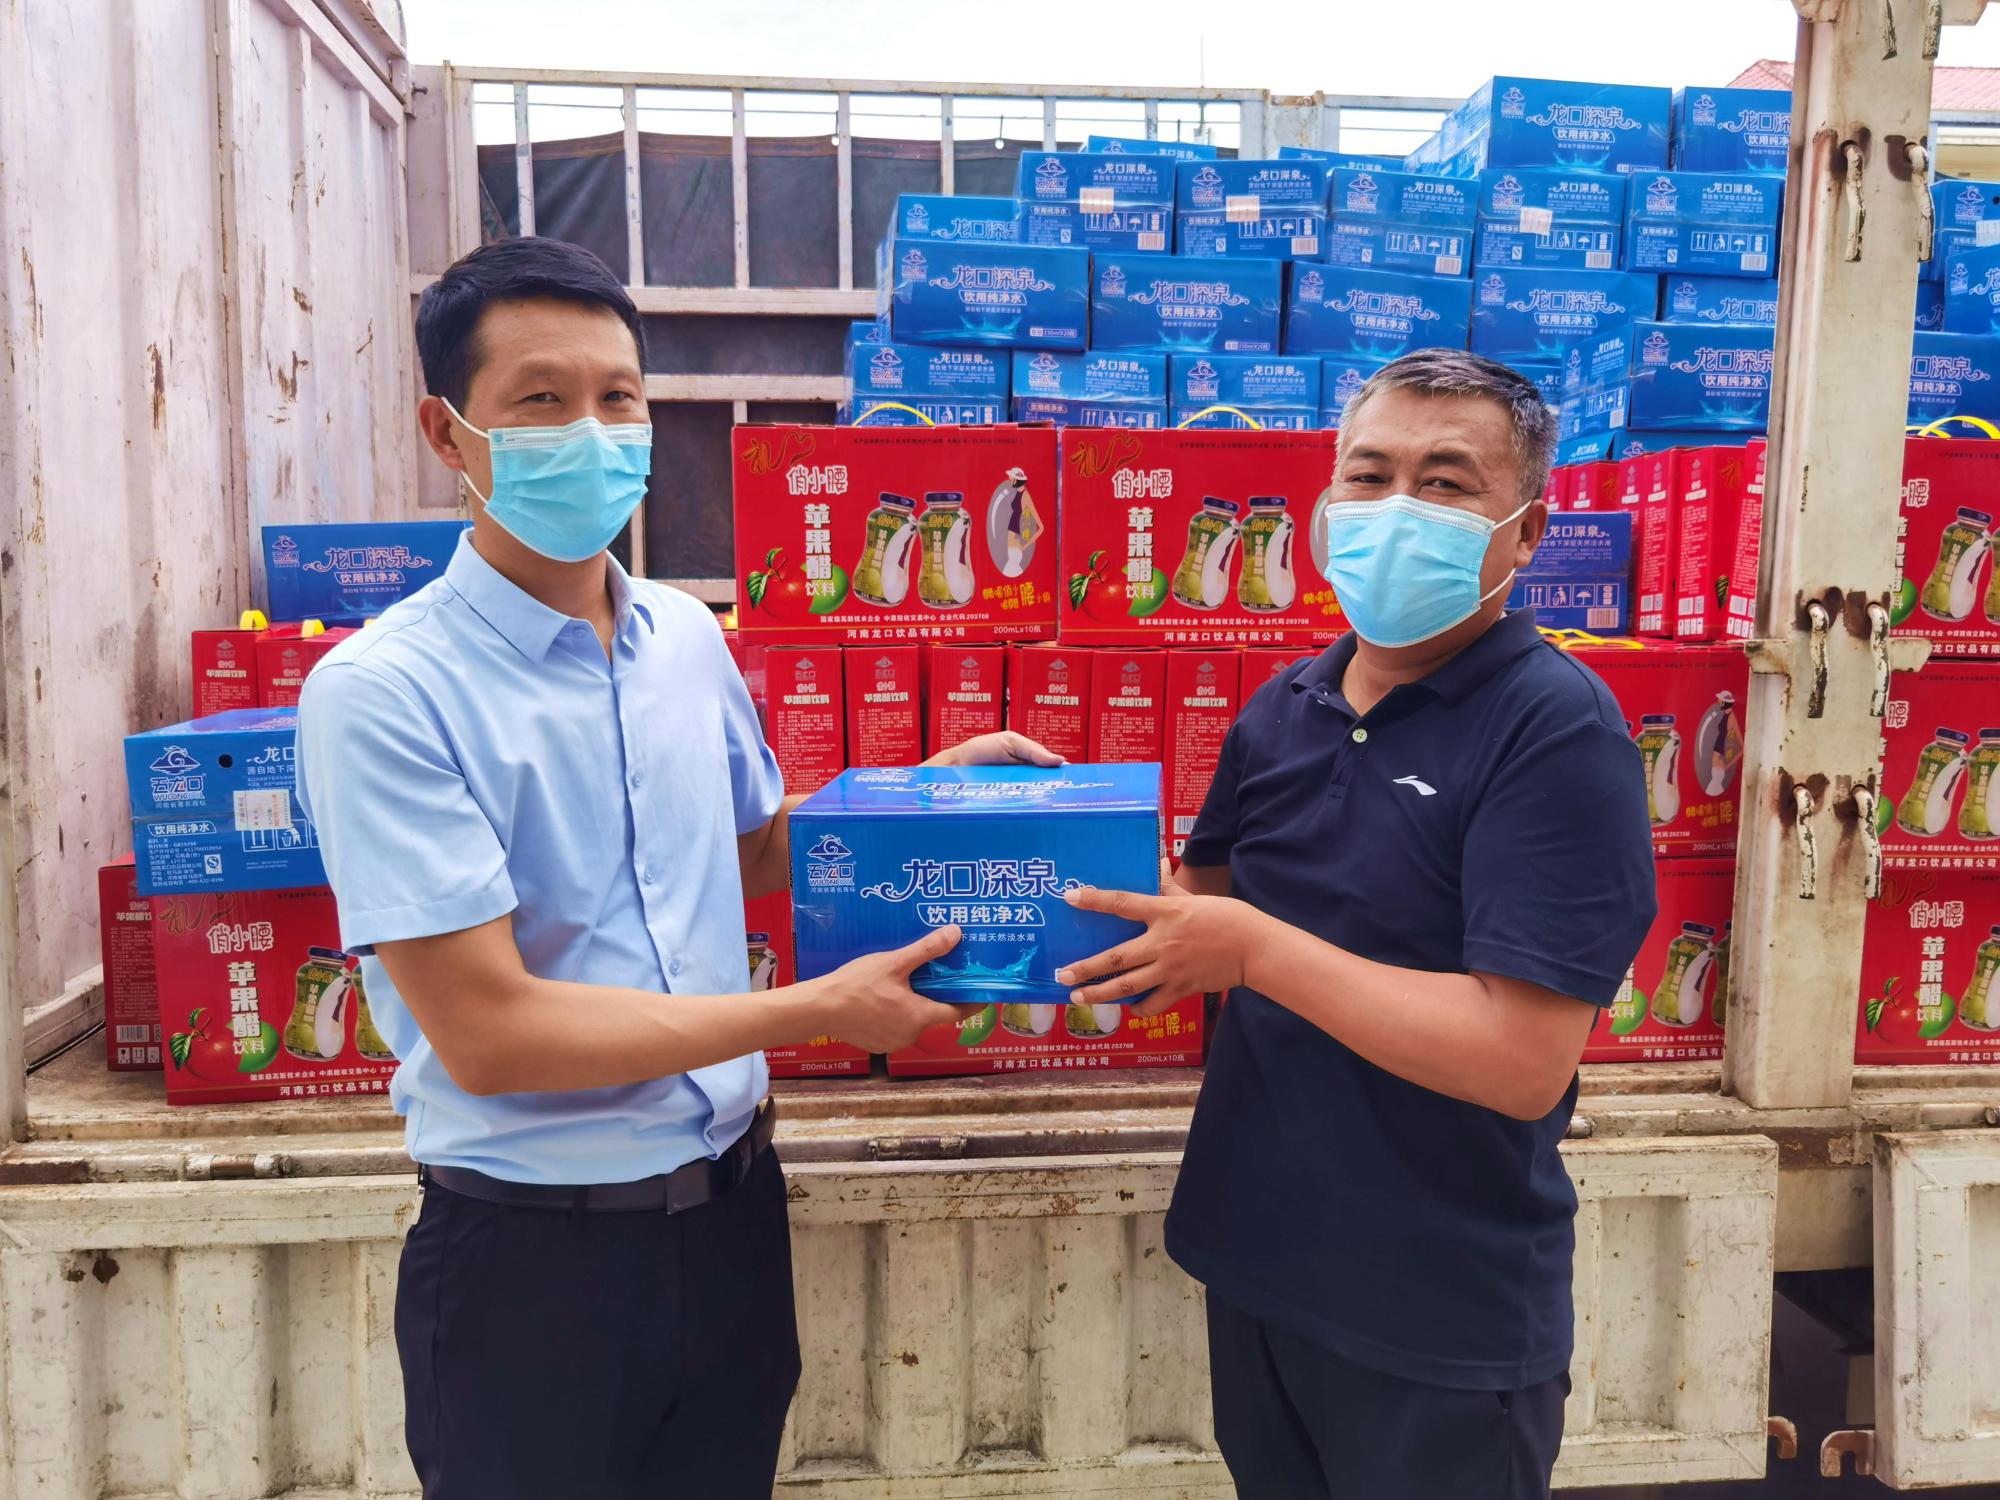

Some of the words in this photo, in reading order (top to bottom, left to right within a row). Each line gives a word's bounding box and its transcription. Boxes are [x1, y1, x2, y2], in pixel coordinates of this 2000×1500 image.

[1549, 104, 1623, 128] 龙口深泉
[1558, 129, 1610, 140] 饮用纯净水
[1104, 163, 1147, 174] 龙口深泉
[1258, 170, 1300, 181] 龙口深泉
[1415, 182, 1456, 194] 龙口深泉
[1558, 182, 1600, 193] 龙口深泉
[1713, 182, 1753, 194] 龙口深泉
[953, 265, 1035, 290] 龙口深泉
[964, 291, 1021, 304] 饮用纯净水
[1151, 280, 1230, 305] 龙口深泉
[1347, 288, 1422, 318] 龙口深泉
[1529, 289, 1607, 314] 龙口深泉
[1161, 306, 1217, 318] 饮用纯净水
[1539, 313, 1593, 326] 饮用纯净水
[1355, 315, 1408, 331] 饮用纯净水
[940, 352, 983, 364] 龙口深泉
[1694, 347, 1773, 373] 龙口深泉
[1096, 360, 1139, 373] 龙口深泉
[1253, 365, 1296, 376] 龙口深泉
[1705, 375, 1762, 386] 饮用纯净水
[785, 463, 849, 495] 俏小腰
[1111, 467, 1173, 498] 俏小腰
[1549, 524, 1599, 537] 龙口深泉
[804, 503, 832, 580] 苹果醋
[1127, 506, 1154, 583] 苹果醋
[325, 546, 410, 569] 龙口深泉
[340, 572, 401, 584] 饮用纯净水
[805, 581, 836, 597] 饮料
[1125, 584, 1155, 599] 饮料
[848, 627, 966, 639] 河南龙口饮品有限公司
[1165, 631, 1284, 642] 河南龙口饮品有限公司
[264, 747, 296, 762] 龙口
[154, 823, 210, 835] 饮用纯净水
[1883, 857, 1996, 868] 河南龙口饮品有限公司
[807, 863, 854, 879] 五龙口
[901, 857, 1058, 900] 龙口深泉
[926, 905, 1036, 925] 饮用纯净水
[1909, 900, 1964, 928] 俏小腰
[206, 921, 274, 954] 俏小腰
[1918, 936, 1946, 1007] 苹果醋
[228, 961, 262, 1039] 苹果醋
[1917, 1009, 1944, 1022] 饮料
[232, 1039, 266, 1056] 饮料
[1643, 1047, 1725, 1058] 河南龙口饮品有
[993, 1056, 1110, 1069] 河南龙口饮品有限公司
